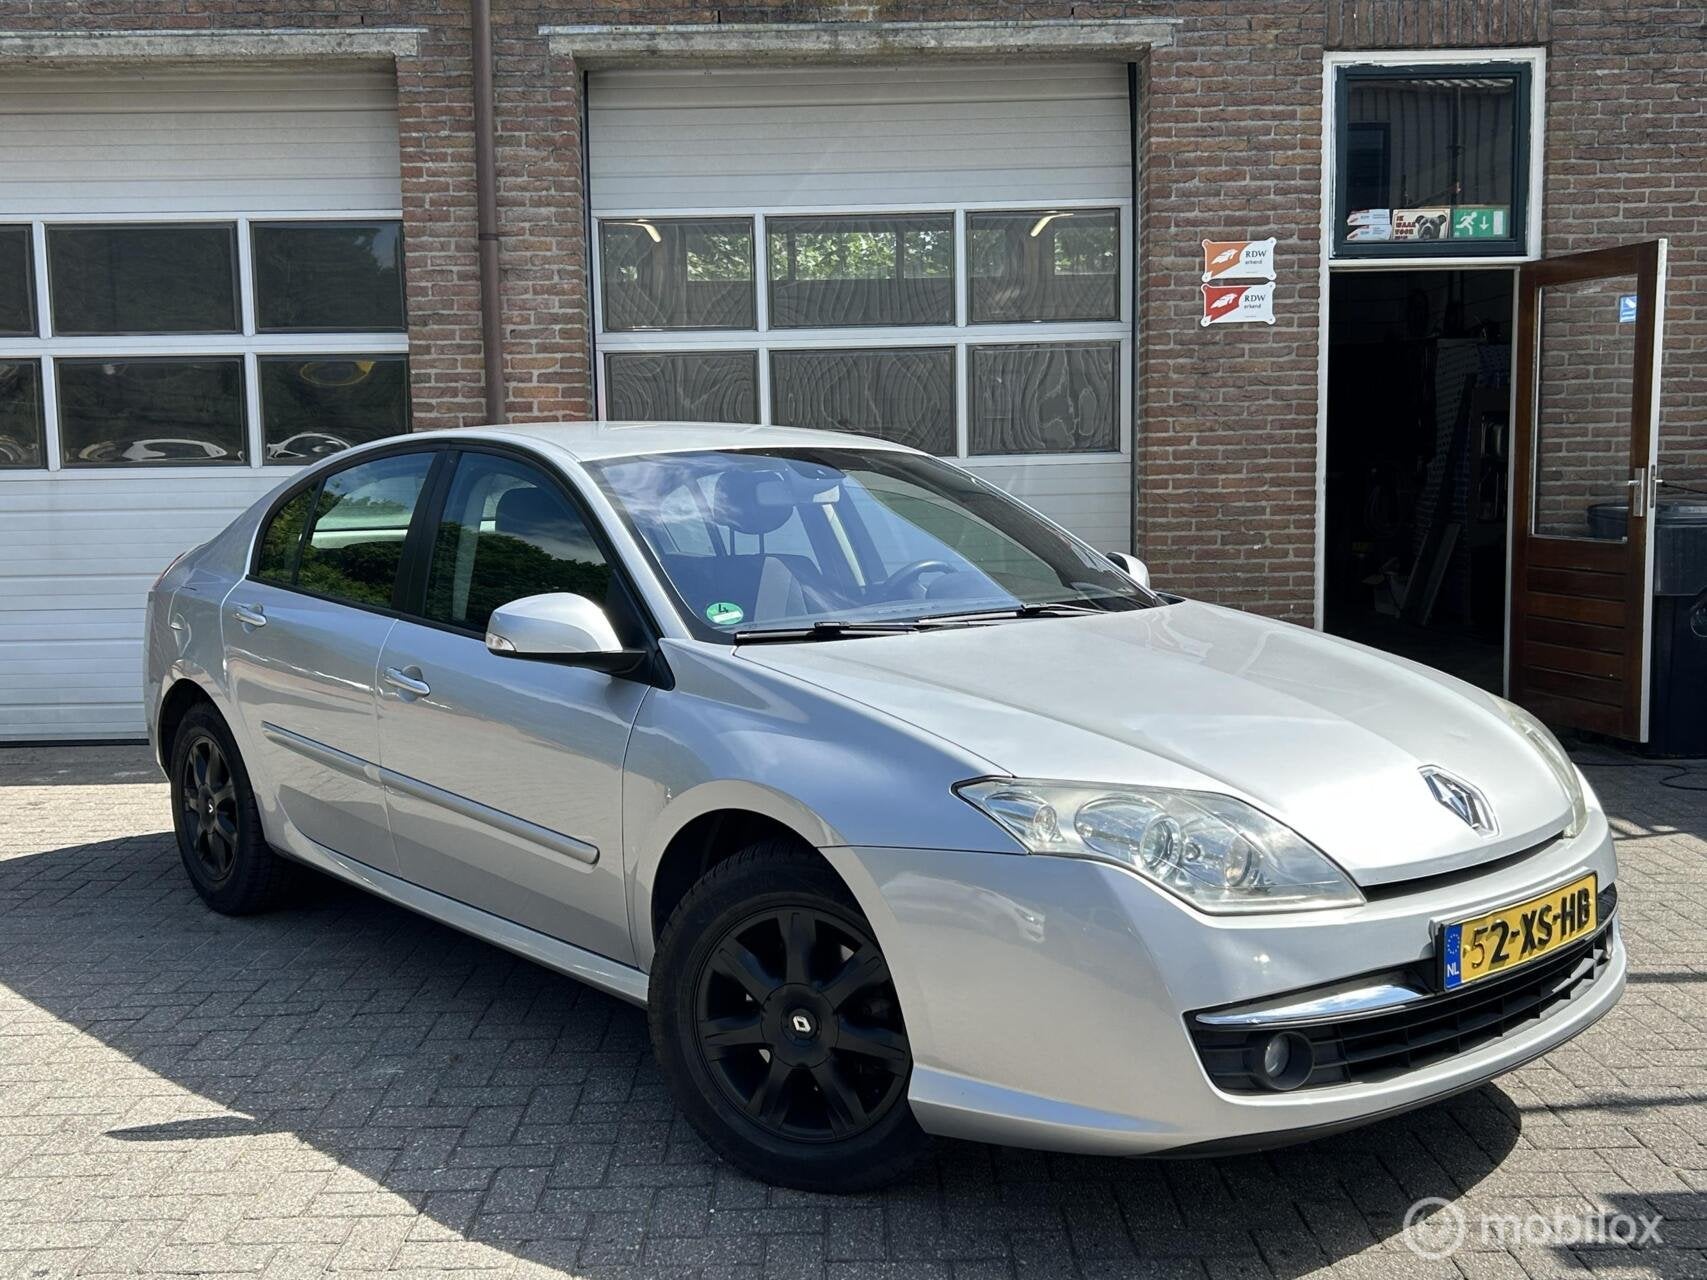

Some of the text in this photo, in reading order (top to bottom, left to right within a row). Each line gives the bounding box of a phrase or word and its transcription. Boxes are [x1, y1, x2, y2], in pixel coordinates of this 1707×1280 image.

[1245, 250, 1267, 258] RDW
[1244, 294, 1266, 302] RDW
[718, 603, 729, 613] 4
[1471, 887, 1591, 970] 52-XS-HB
[1446, 962, 1460, 978] NL
